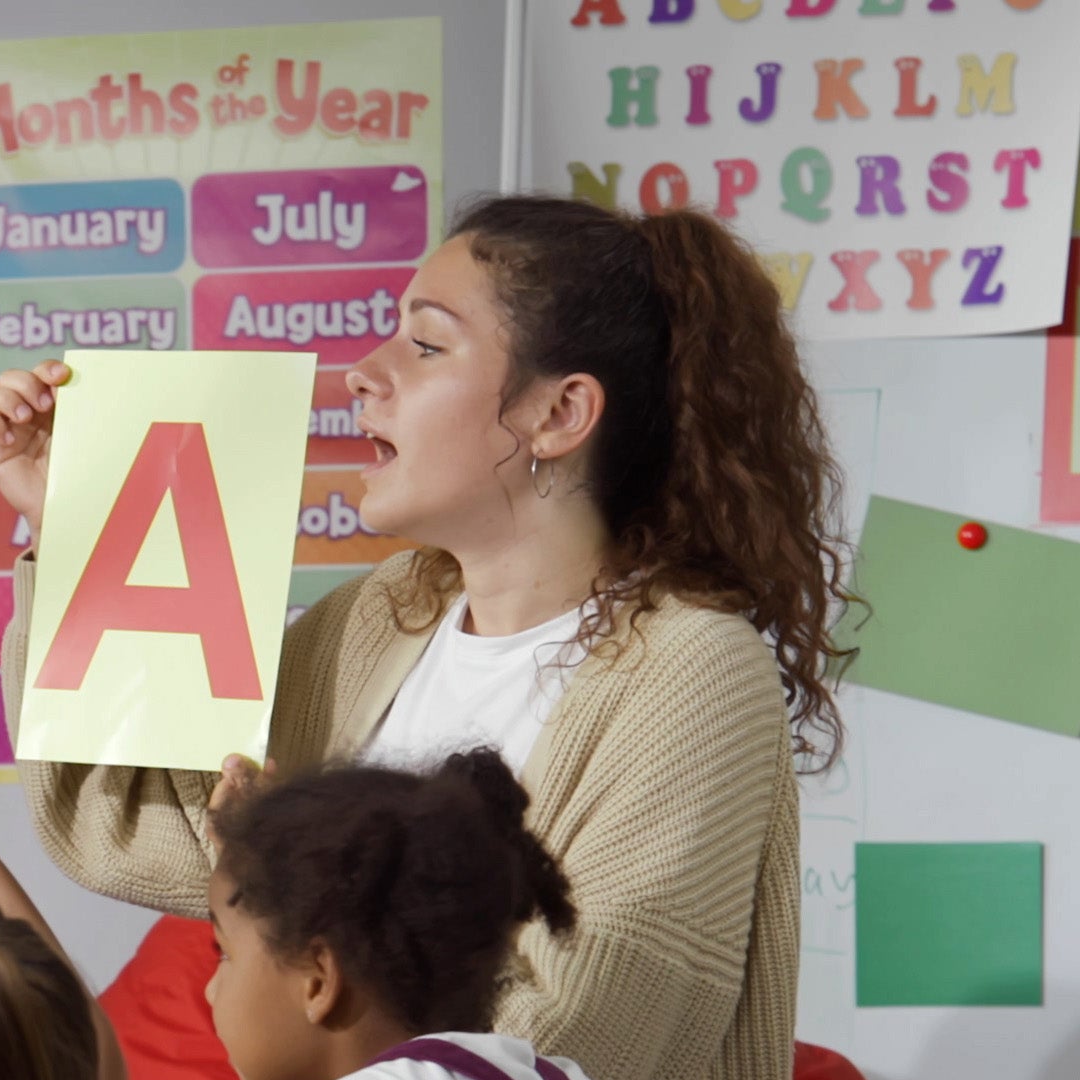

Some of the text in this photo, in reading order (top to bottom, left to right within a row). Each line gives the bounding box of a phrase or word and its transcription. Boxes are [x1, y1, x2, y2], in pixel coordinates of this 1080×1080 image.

[218, 54, 250, 86] of
[272, 59, 430, 141] Year
[606, 53, 1017, 128] H I J K L M
[210, 93, 267, 128] the
[567, 147, 1041, 223] N O P Q R S T
[251, 191, 366, 250] July
[828, 249, 883, 312] X
[897, 249, 950, 311] Y
[961, 246, 1004, 306] Z
[224, 290, 397, 344] August
[33, 421, 264, 701] A
